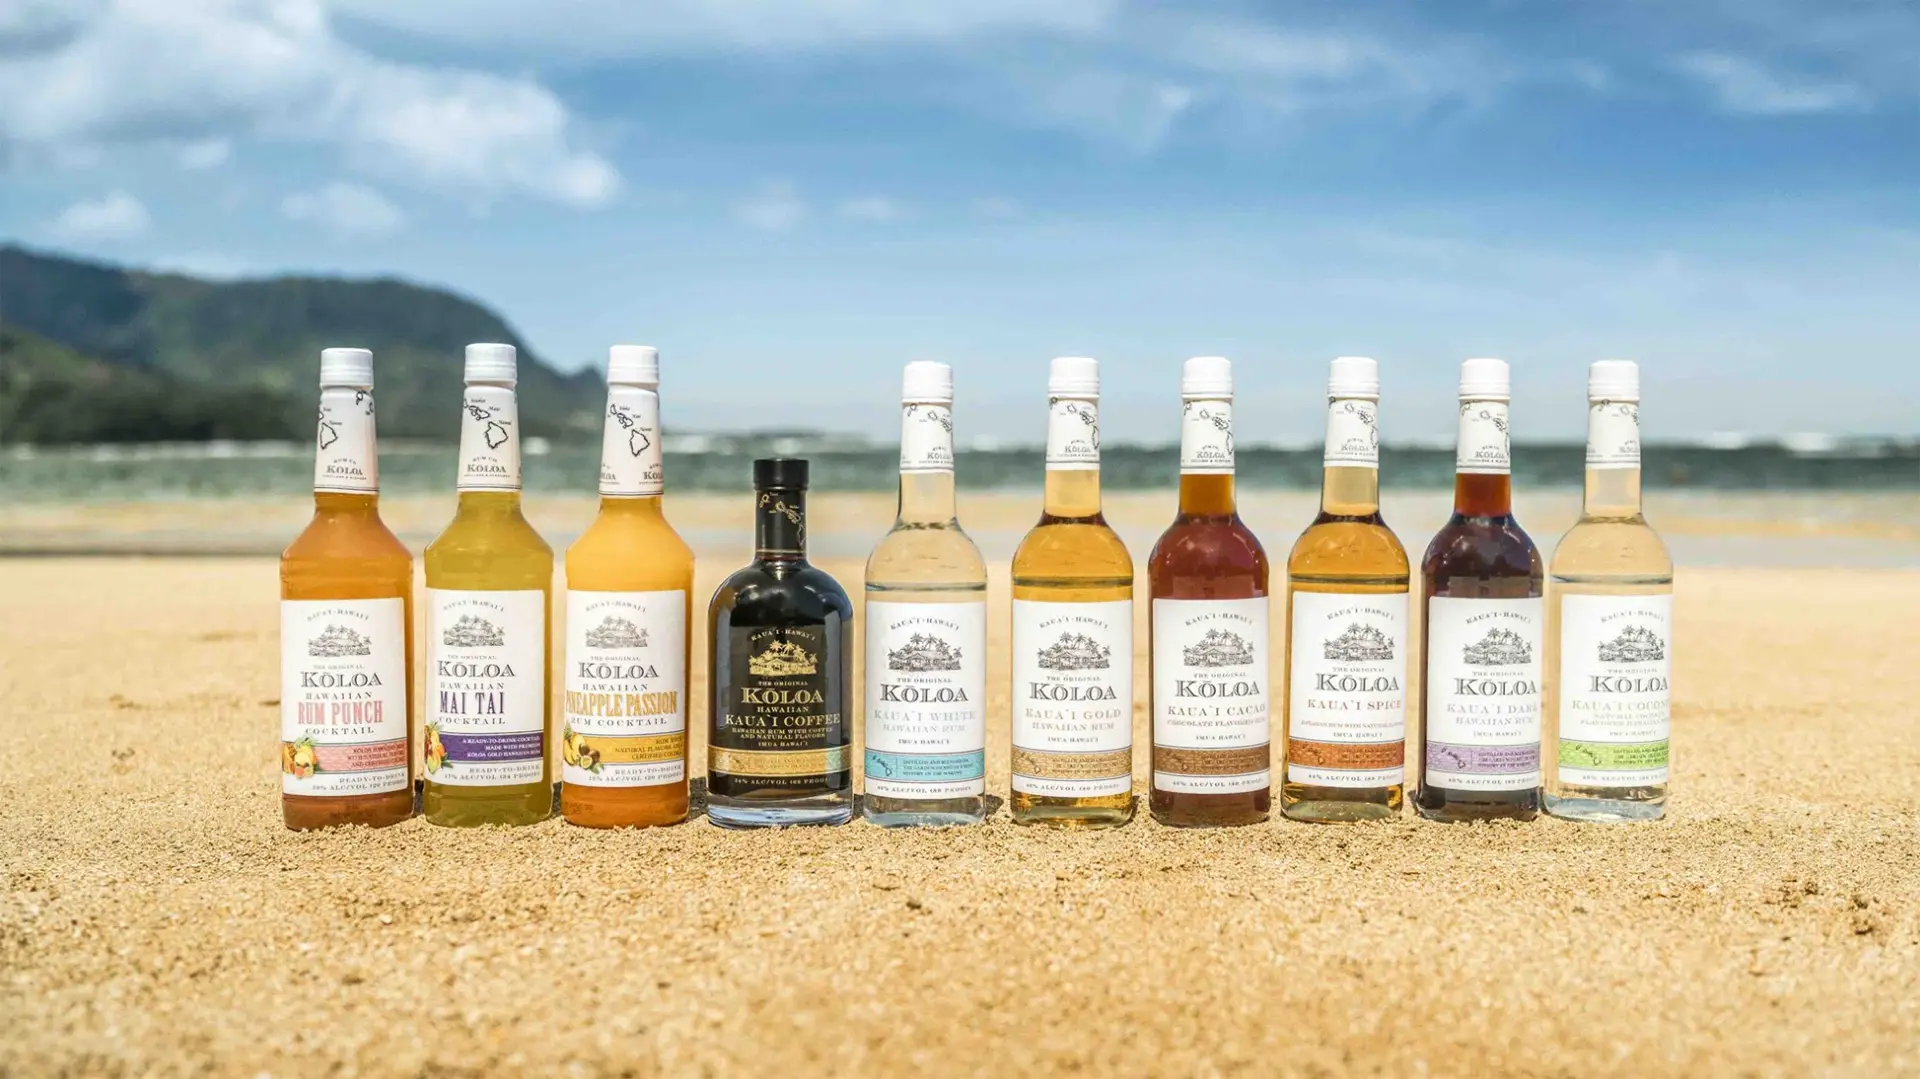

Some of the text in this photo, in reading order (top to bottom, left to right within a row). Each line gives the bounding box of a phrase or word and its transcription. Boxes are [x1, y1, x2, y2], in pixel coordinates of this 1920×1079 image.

[440, 682, 505, 691] HAWAIIAN
[582, 683, 649, 692] HAWAIIAN
[305, 692, 373, 700] HAWAIIAN
[440, 691, 505, 715] MAI TAI
[626, 691, 678, 717] PASSION
[298, 700, 384, 725] RUM PUNCH
[1083, 708, 1122, 720] GOLD
[1226, 704, 1266, 717] CACAO
[784, 713, 841, 727] COFFEE
[930, 710, 977, 722] WHITE
[1456, 716, 1511, 726] HAWAIIAN
[438, 717, 506, 726] COCKTAIL
[597, 717, 667, 727] COCKTAIL
[1032, 721, 1087, 732] HAWAIIAN
[305, 727, 375, 736] COCKTAIL
[883, 724, 938, 733] HAWAIIAN
